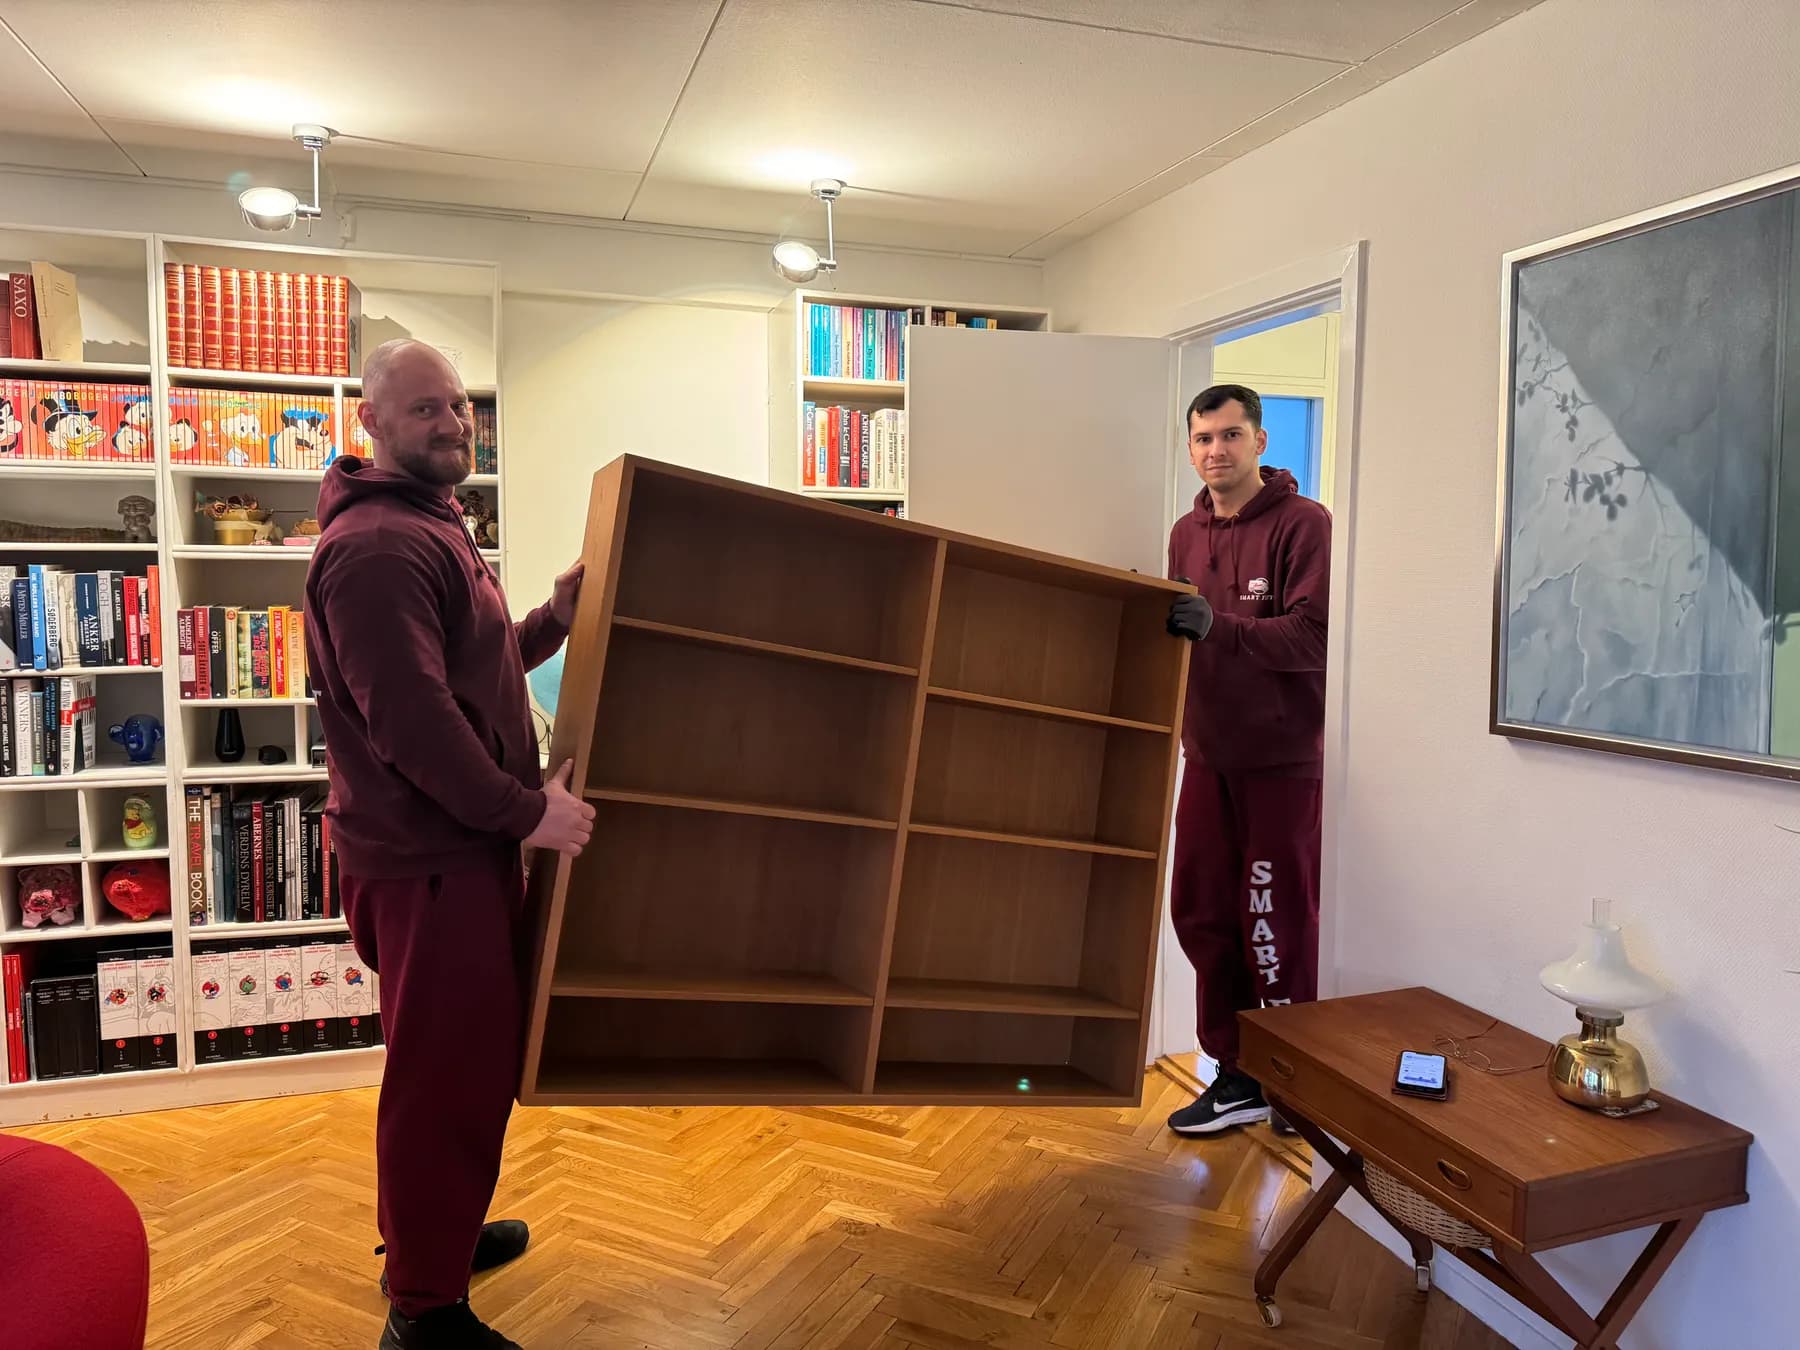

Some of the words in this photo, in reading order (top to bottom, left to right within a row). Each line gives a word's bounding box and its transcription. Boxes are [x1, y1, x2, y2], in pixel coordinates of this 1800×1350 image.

[13, 277, 27, 318] SAXO
[17, 590, 27, 612] MYTEN
[99, 578, 109, 607] FOGH
[19, 613, 28, 639] MØLLER
[47, 608, 58, 647] SØDERBERG
[88, 614, 99, 651] ANKER
[19, 686, 29, 732] WINNERS
[189, 798, 200, 822] THE
[190, 824, 202, 870] TRAVEL
[239, 825, 249, 872] VERDENS
[253, 817, 262, 860] ABERNES
[191, 872, 203, 908] BOOK
[240, 872, 250, 911] DYRELIV
[1249, 861, 1279, 985] SMART
